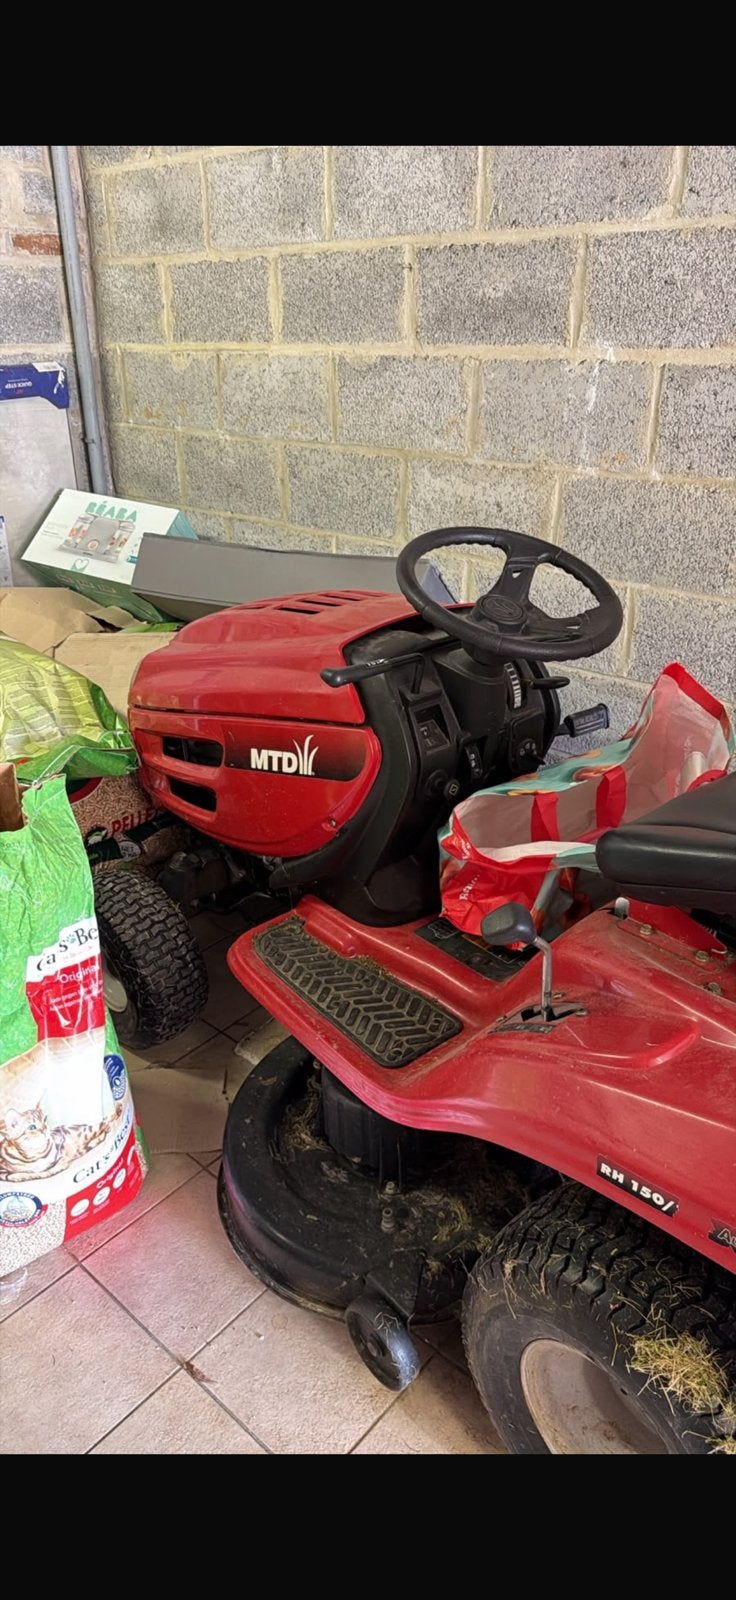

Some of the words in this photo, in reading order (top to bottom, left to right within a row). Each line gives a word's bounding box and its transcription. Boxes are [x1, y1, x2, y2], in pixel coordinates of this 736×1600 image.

[85, 501, 137, 522] BÉABA
[250, 747, 298, 773] MTD
[600, 1163, 624, 1184] RH
[631, 1180, 678, 1211] 150/
